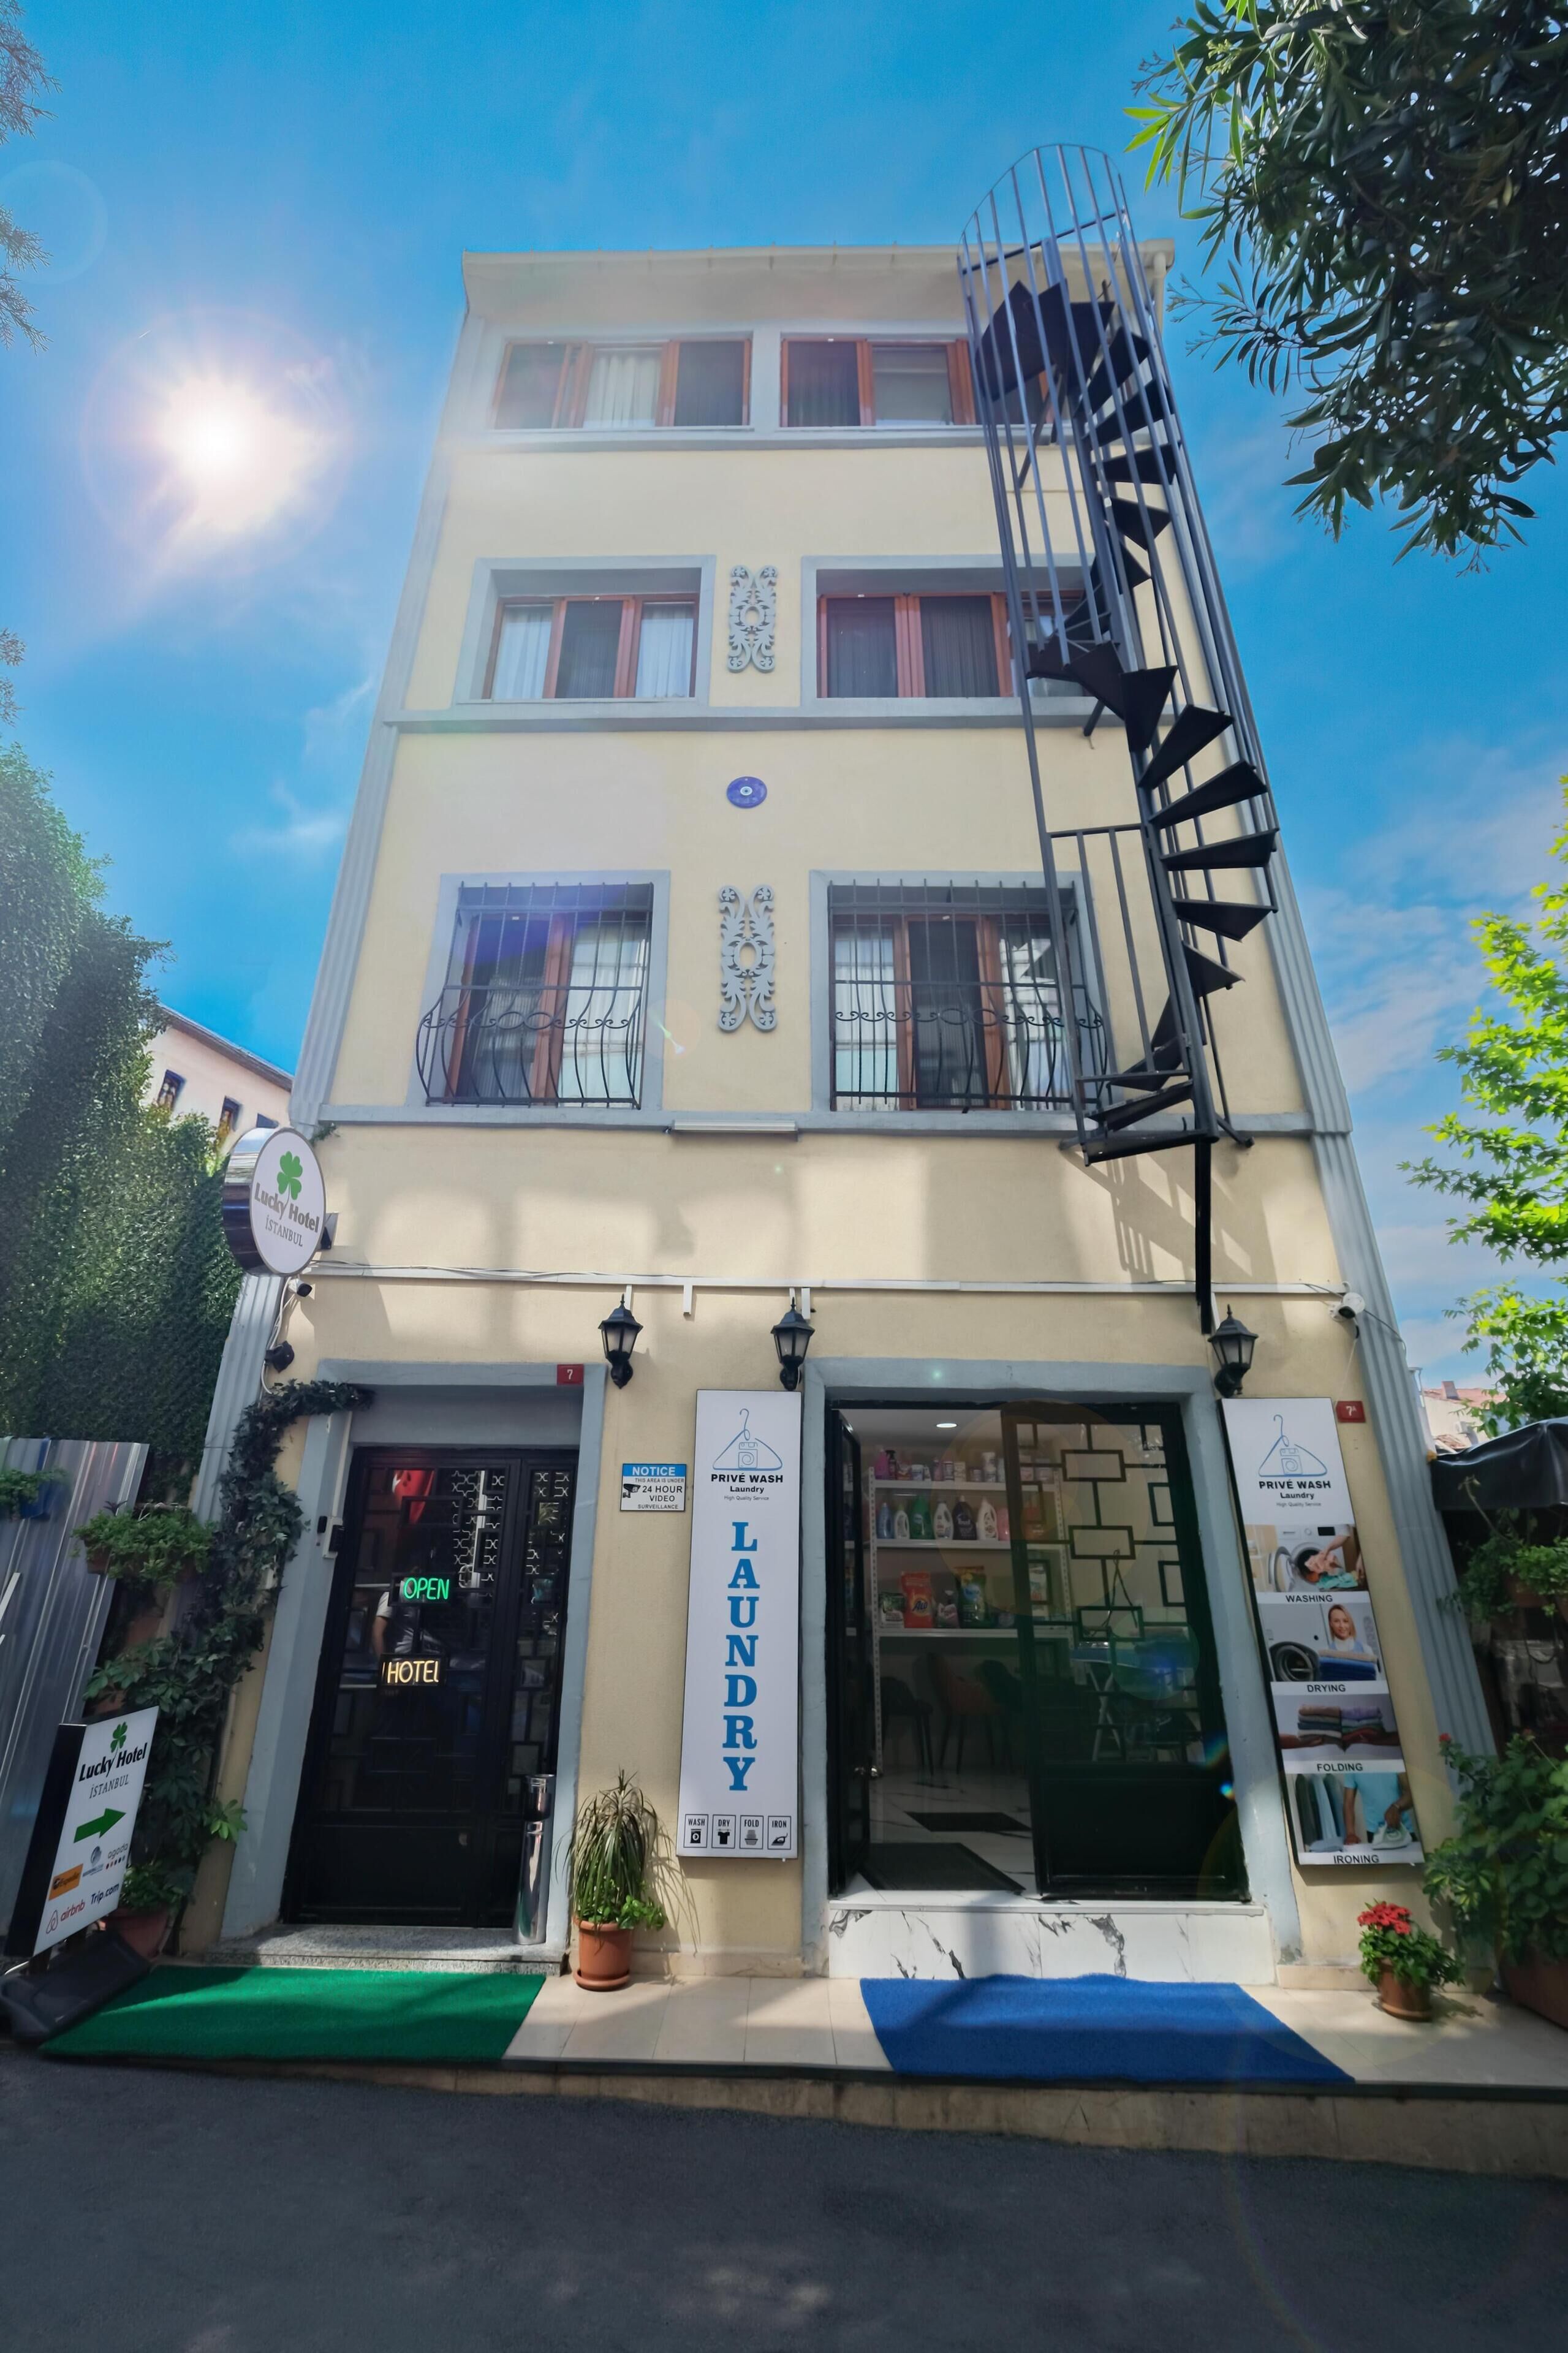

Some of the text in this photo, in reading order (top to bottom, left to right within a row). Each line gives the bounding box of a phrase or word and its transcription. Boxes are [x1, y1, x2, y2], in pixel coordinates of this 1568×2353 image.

[254, 1183, 320, 1232] Lucky Hotel
[265, 1214, 303, 1247] İSTANBUL
[567, 1369, 573, 1380] 7
[632, 1466, 675, 1476] NOTICE
[711, 1473, 783, 1483] PRIVÉ WASH
[730, 1485, 764, 1494] Laundry
[1259, 1479, 1331, 1489] PRIVÉ WASH
[403, 1578, 449, 1601] OPEN
[722, 1521, 760, 1791] LAUNDRY
[387, 1660, 439, 1684] HOTEL
[79, 1742, 148, 1782] Lucky Hotel
[1317, 1763, 1363, 1771] FOLDING
[89, 1774, 129, 1799] İSTANBUL
[107, 1843, 128, 1859] agoda
[1333, 1855, 1379, 1864] IRONING
[91, 1884, 119, 1904] Trip.com
[60, 1900, 85, 1922] airbnb
